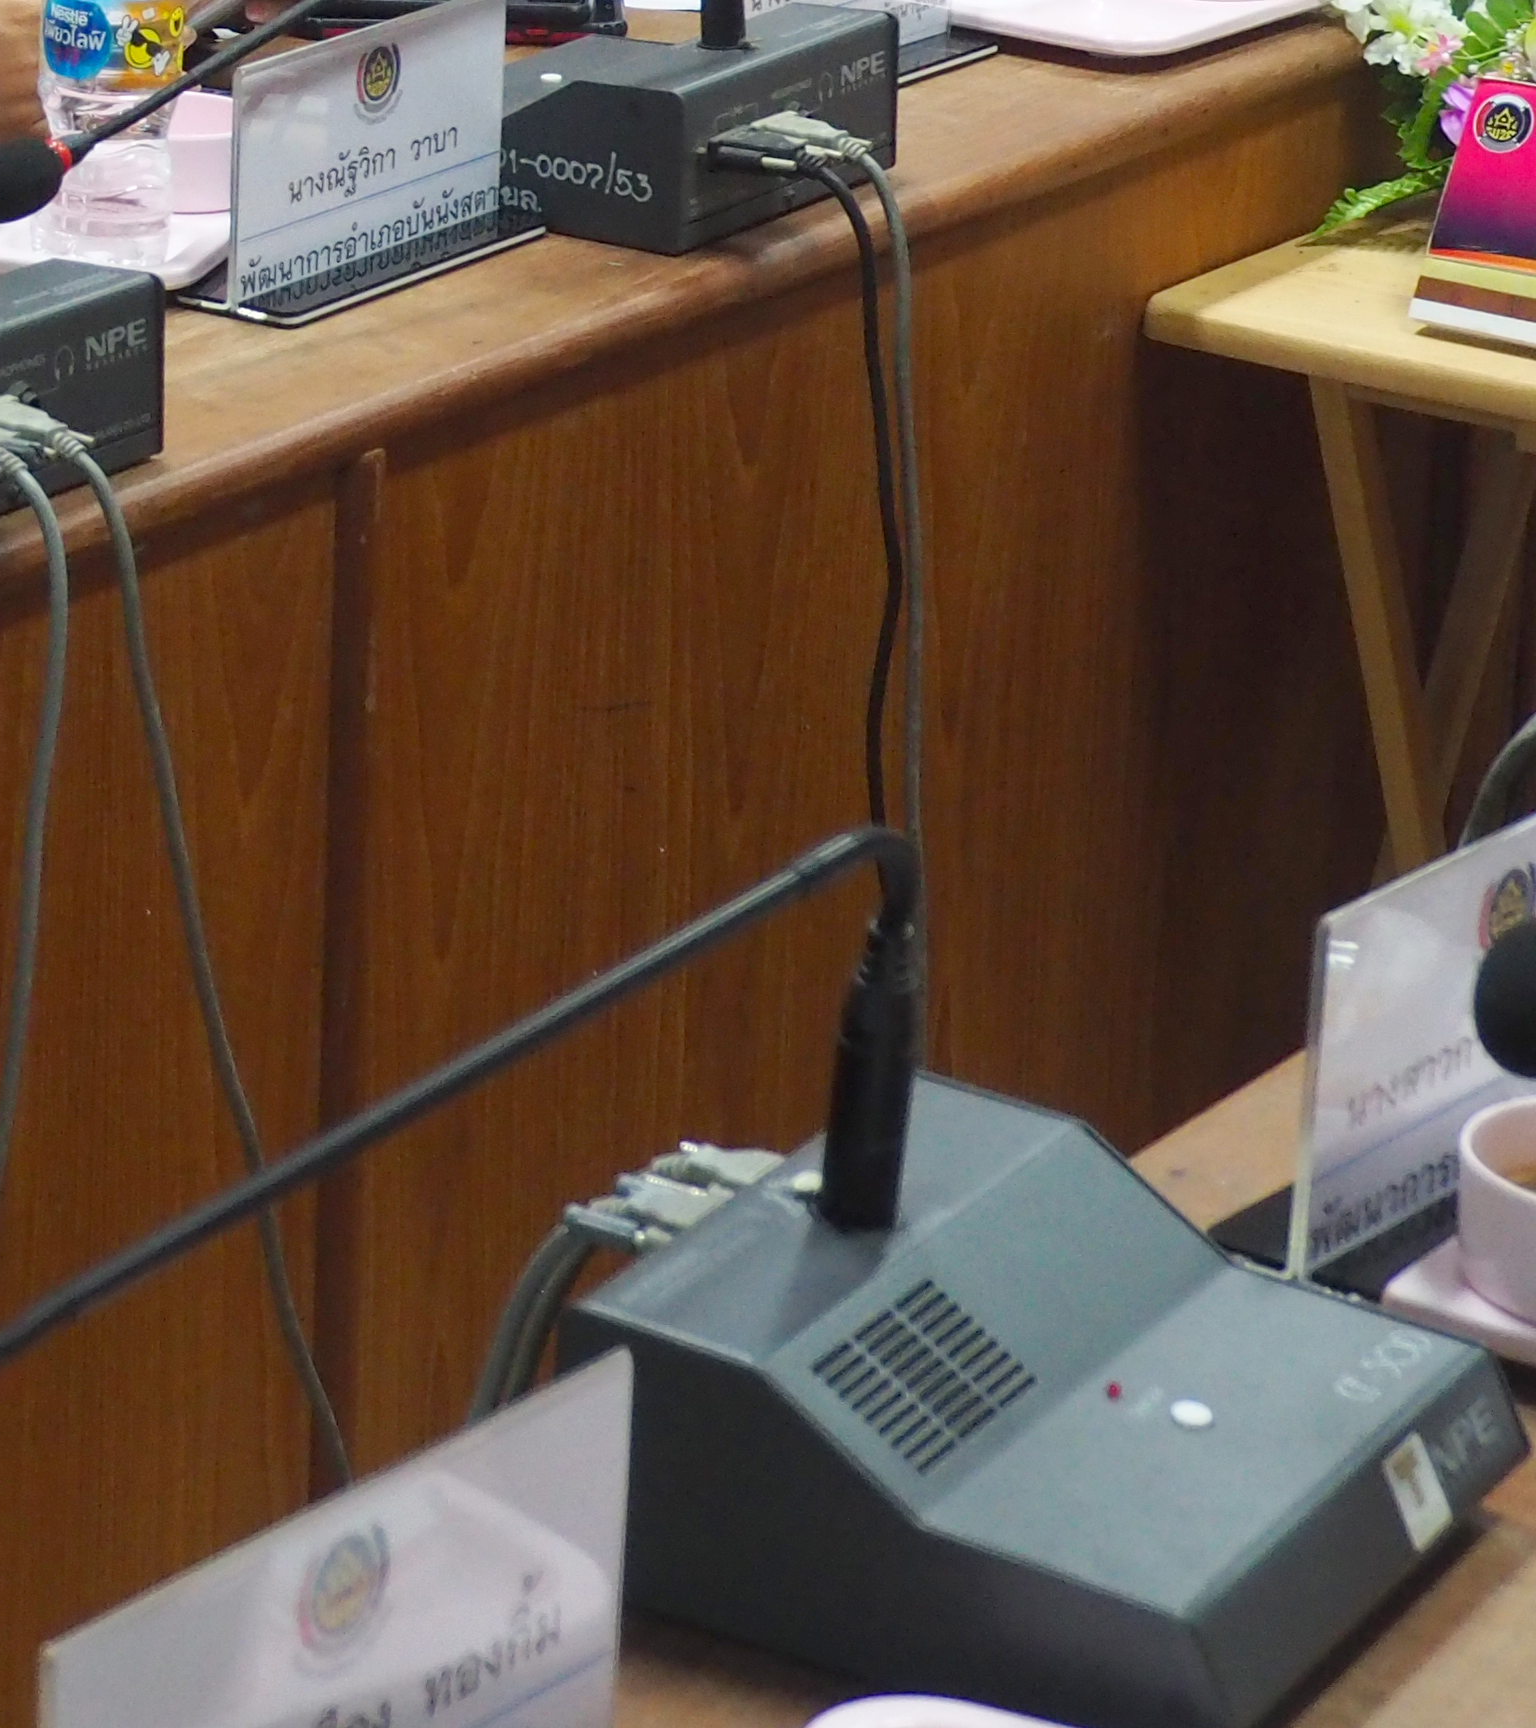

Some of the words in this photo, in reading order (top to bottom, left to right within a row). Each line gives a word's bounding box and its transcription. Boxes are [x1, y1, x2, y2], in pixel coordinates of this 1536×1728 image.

[839, 49, 887, 85] NPE
[410, 126, 459, 161] วาบา
[85, 317, 148, 362] NPE
